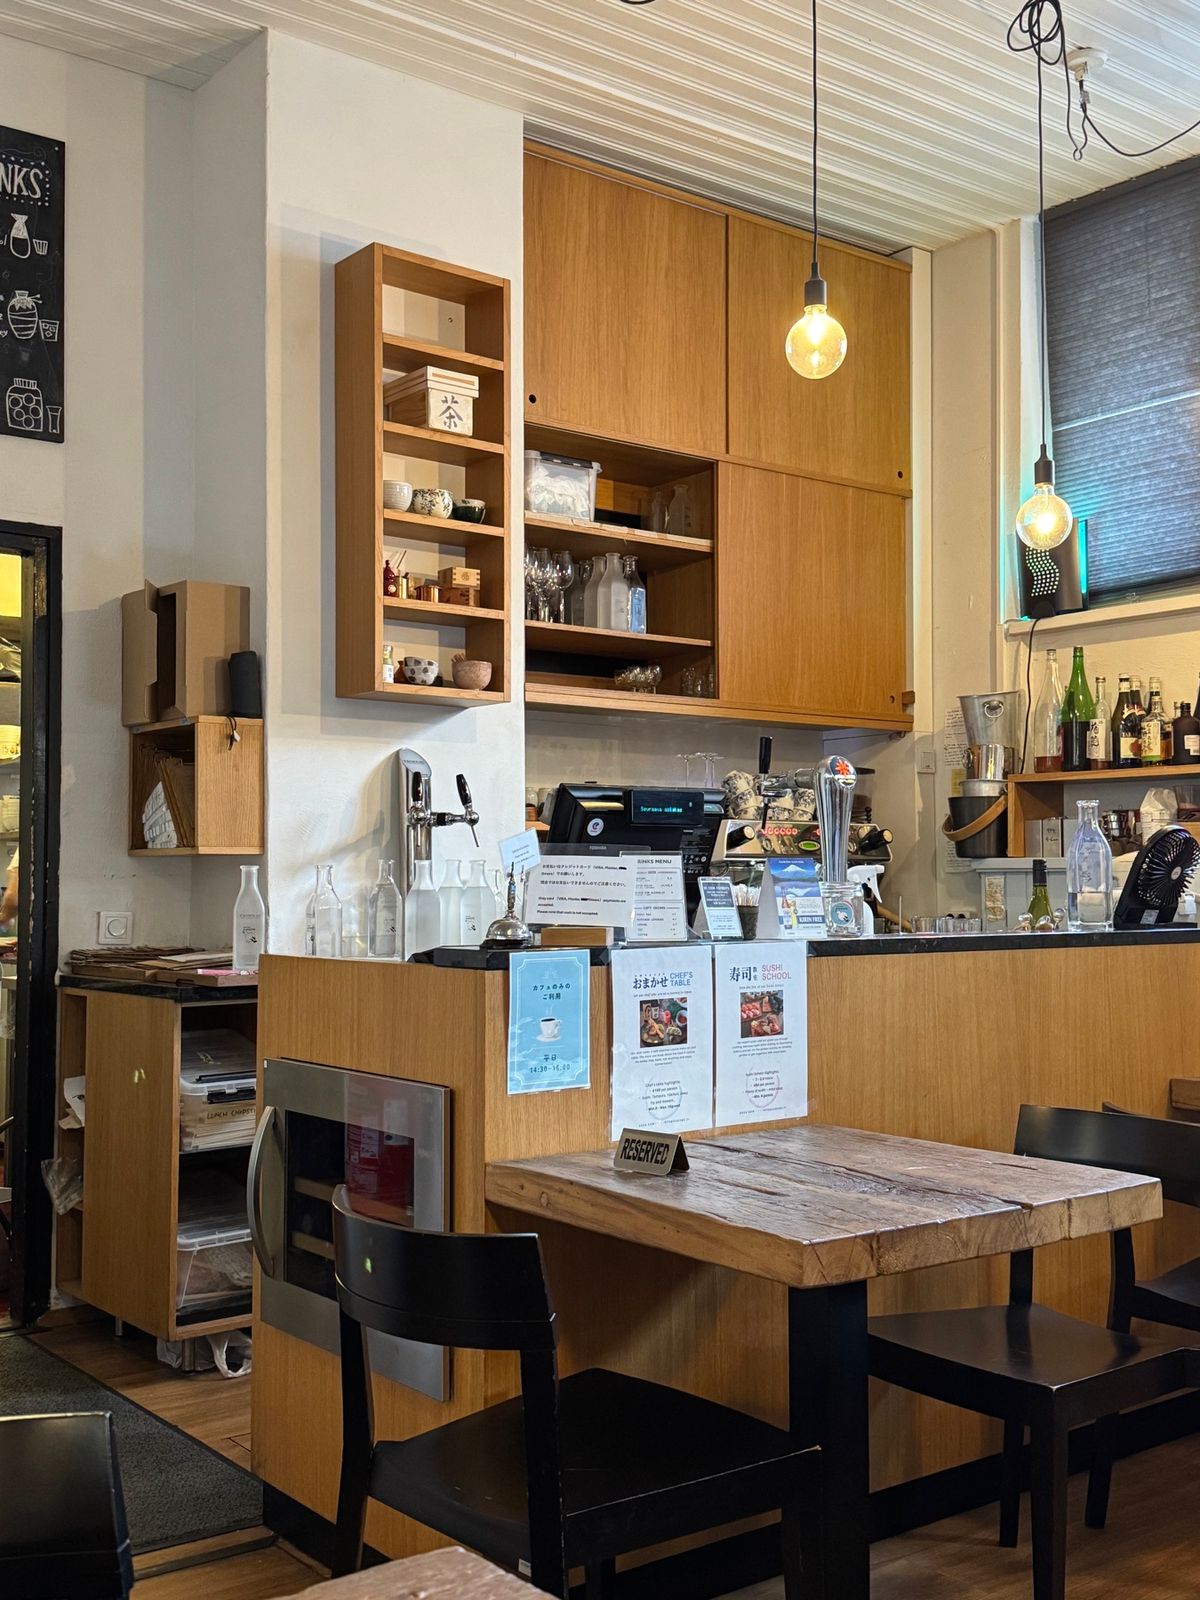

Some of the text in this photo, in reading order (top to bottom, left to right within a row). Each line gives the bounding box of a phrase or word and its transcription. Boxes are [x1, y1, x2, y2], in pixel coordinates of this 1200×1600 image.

[439, 395, 464, 430] 茶
[761, 964, 783, 972] SUSHI
[729, 967, 752, 982] 寿司
[762, 972, 791, 980] SCHOOL
[633, 976, 668, 990] おまかせ
[670, 979, 691, 987] TABLE
[207, 1111, 228, 1119] LUNCH
[620, 1138, 670, 1165] RESERVED
